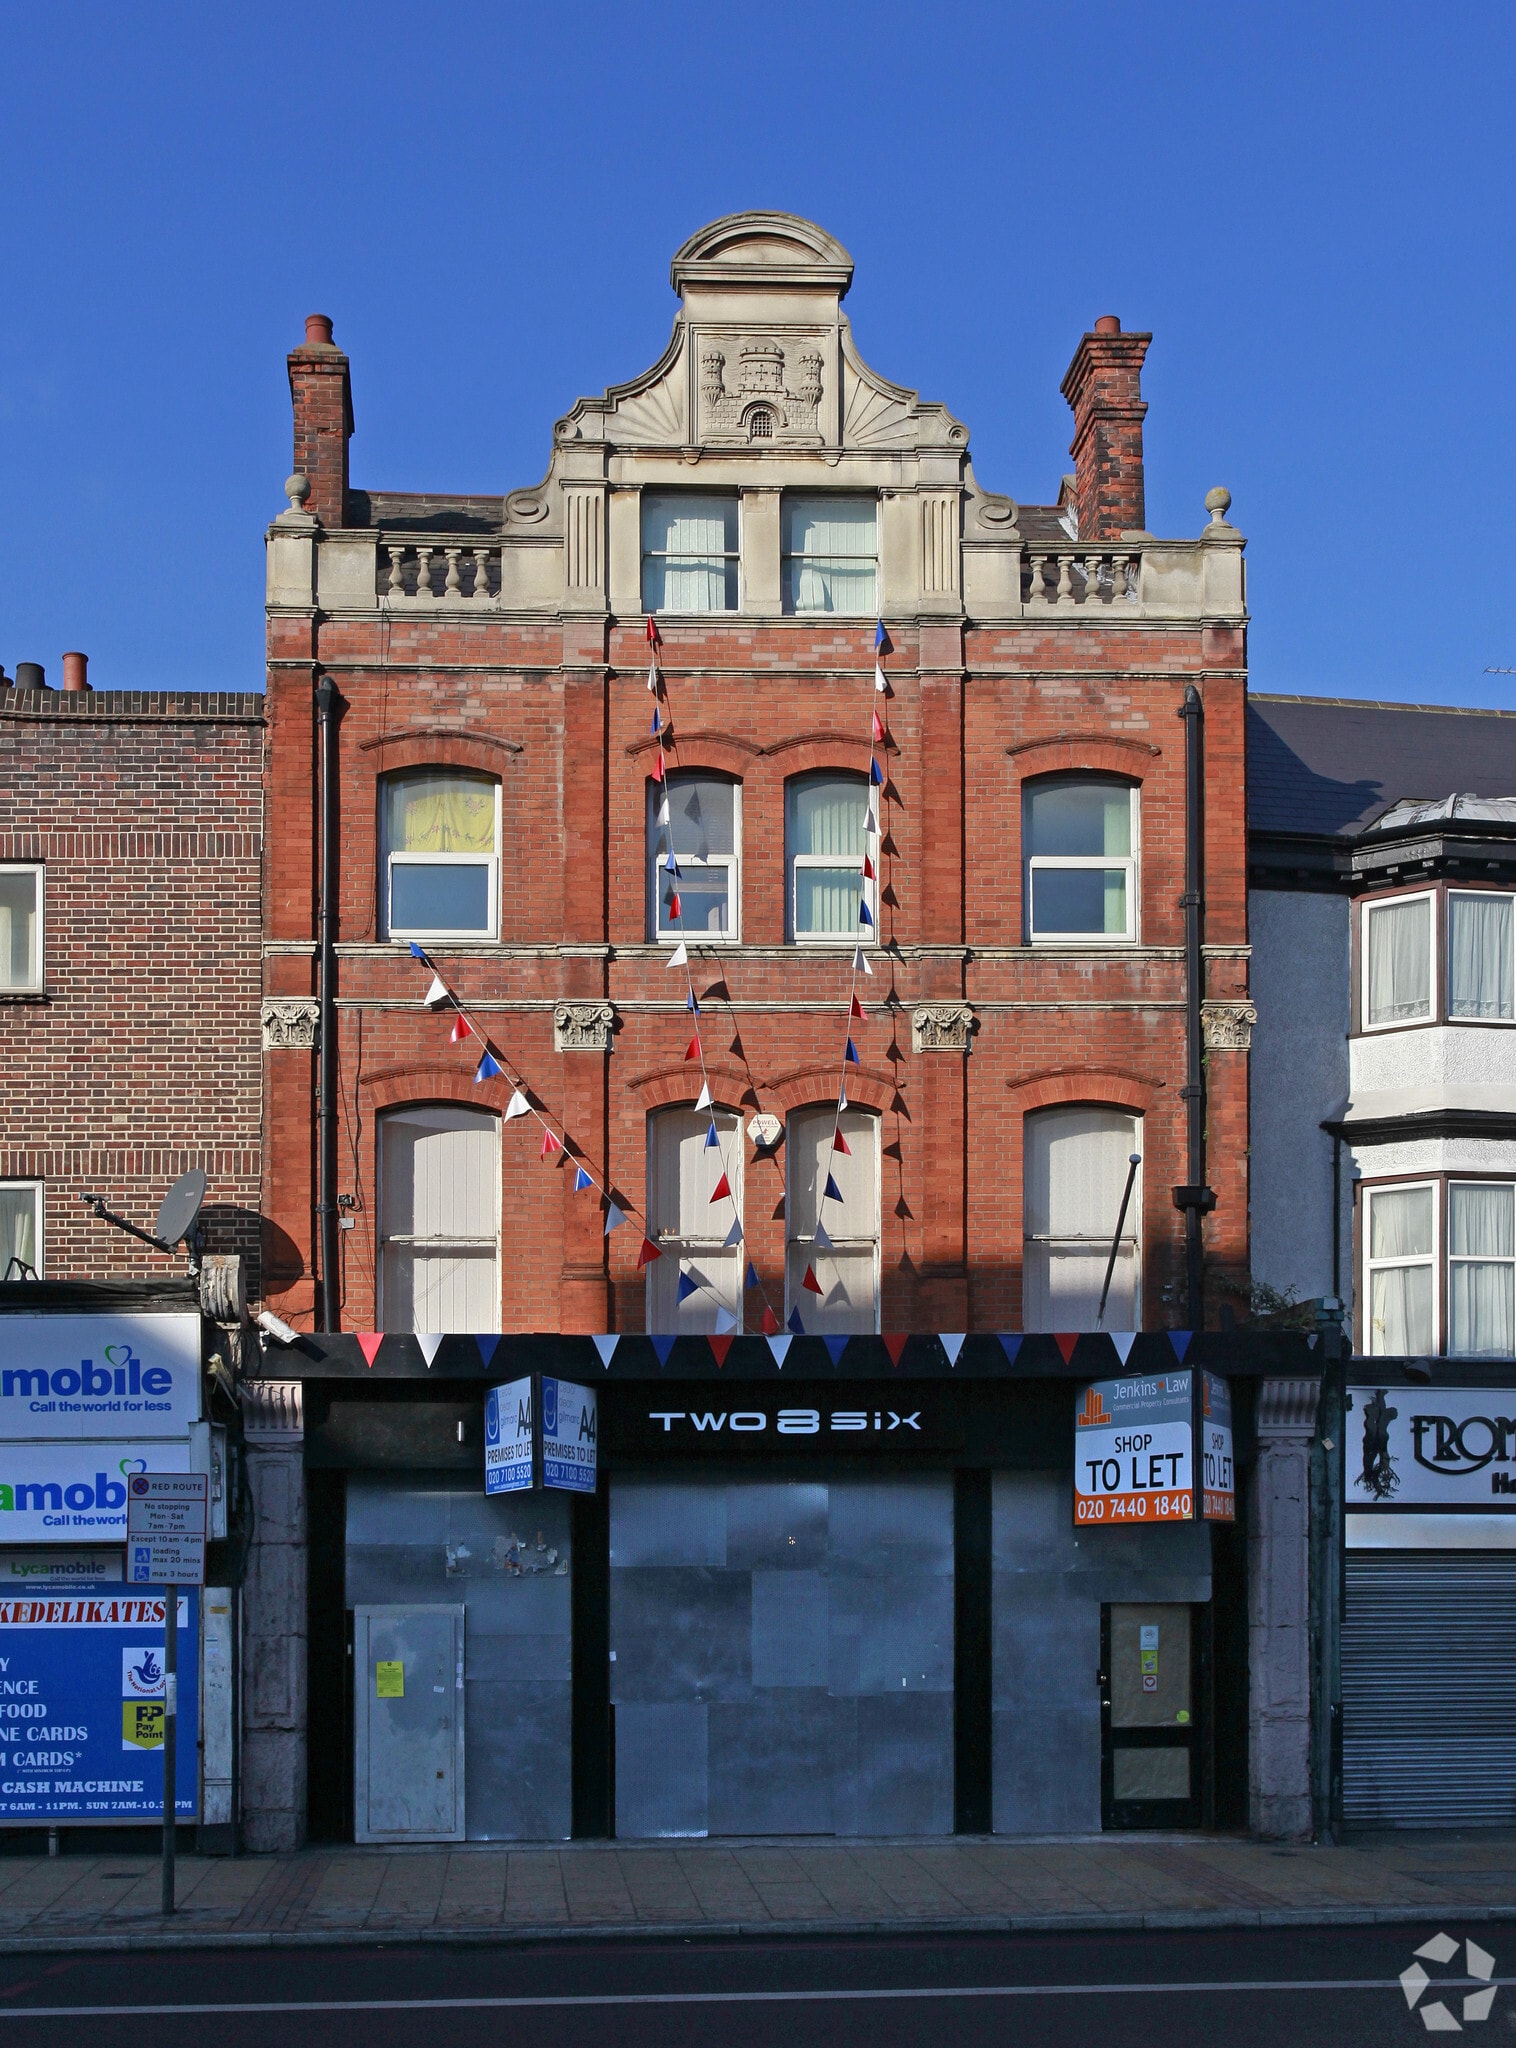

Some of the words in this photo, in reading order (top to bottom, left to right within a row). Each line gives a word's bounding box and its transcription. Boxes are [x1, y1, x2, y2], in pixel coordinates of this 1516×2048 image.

[0, 1359, 173, 1396] mobile
[1113, 1380, 1157, 1400] Jenkins
[1165, 1376, 1189, 1393] Law
[29, 1401, 56, 1413] Call
[58, 1401, 81, 1412] the
[82, 1401, 121, 1412] world
[123, 1400, 141, 1411] for
[144, 1400, 172, 1411] less
[1112, 1400, 1140, 1412] Commercial
[1140, 1399, 1162, 1409] Property
[1163, 1396, 1190, 1406] Consultants
[578, 1405, 596, 1444] A4
[649, 1412, 767, 1431] TWO
[777, 1409, 820, 1434] 8
[1114, 1434, 1152, 1453] SHOP
[1211, 1433, 1225, 1450] SHOP
[487, 1446, 514, 1464] PREMISES
[515, 1444, 523, 1458] TO
[524, 1440, 532, 1456] LET
[544, 1441, 575, 1460] PREMISES
[576, 1447, 585, 1461] TO
[587, 1449, 596, 1464] LET
[488, 1470, 500, 1485] 020
[501, 1467, 516, 1482] 7100
[516, 1464, 531, 1479] 5520
[545, 1463, 559, 1477] 020
[561, 1465, 577, 1480] 7100
[579, 1467, 594, 1483] 5520
[1085, 1458, 1121, 1492] TO
[1131, 1452, 1184, 1490] LET
[1204, 1453, 1216, 1488] TO
[1217, 1455, 1232, 1488] LET
[173, 1483, 202, 1491] ROUTE
[157, 1503, 190, 1511] stopping
[1077, 1500, 1104, 1519] 020
[1110, 1497, 1147, 1518] 7440
[1154, 1494, 1191, 1515] 1840
[42, 1515, 70, 1526] Call
[72, 1514, 95, 1526] the
[96, 1514, 128, 1525] worl
[131, 1535, 156, 1543] Except
[11, 1561, 106, 1577] Lycamobile
[0, 1680, 39, 1695] NCE
[130, 1681, 158, 1693] National
[26, 1726, 88, 1742] CARDS
[136, 1723, 154, 1732] Pay
[136, 1731, 163, 1739] Point
[2, 1781, 50, 1794] CASH
[54, 1780, 144, 1793] MACHINE
[10, 1802, 36, 1811] 6AM
[86, 1801, 108, 1810] SUN
